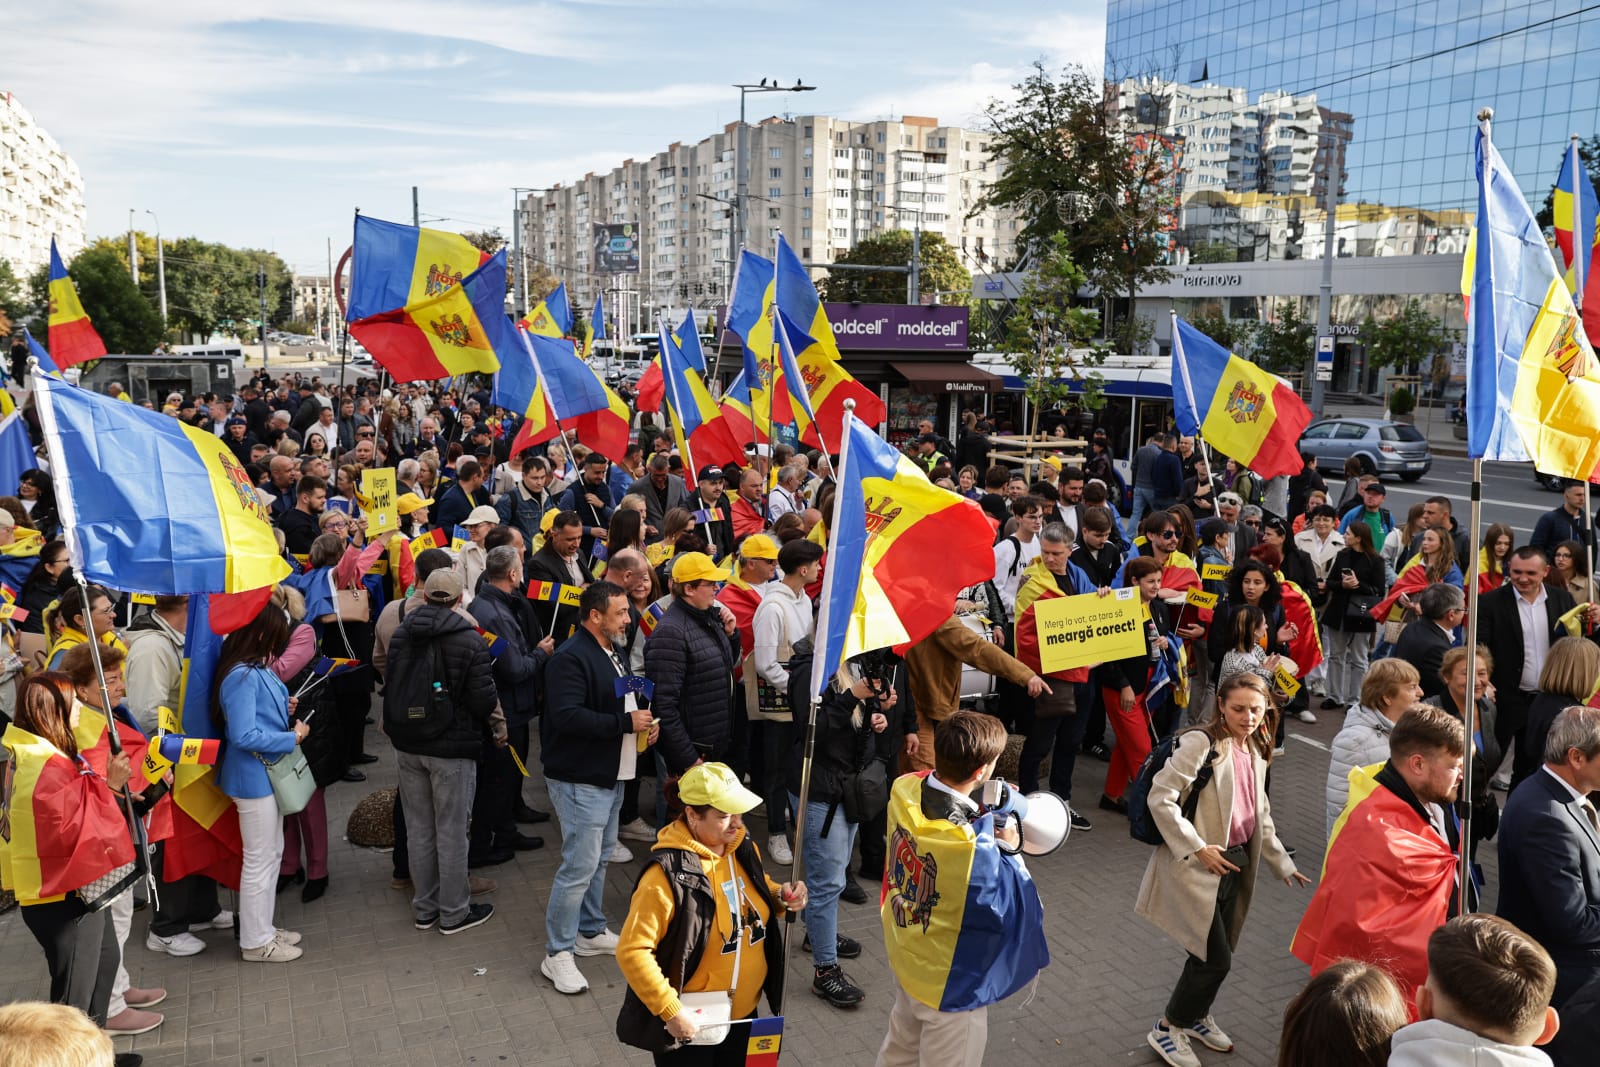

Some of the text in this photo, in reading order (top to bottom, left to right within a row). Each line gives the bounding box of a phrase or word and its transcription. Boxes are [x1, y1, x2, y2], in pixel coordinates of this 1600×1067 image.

[897, 321, 957, 336] moldcell
[952, 383, 985, 391] MoldPresa
[379, 490, 391, 509] vot!
[564, 590, 580, 600] /pa
[1189, 592, 1213, 605] /pas/
[1044, 618, 1064, 630] Merg
[1065, 617, 1073, 626] la
[1074, 615, 1087, 624] vot,
[1088, 615, 1097, 623] ca
[1115, 609, 1123, 618] să
[1046, 618, 1136, 646] meargă corect!
[1276, 669, 1295, 690] /pas/
[144, 754, 165, 774] as/
